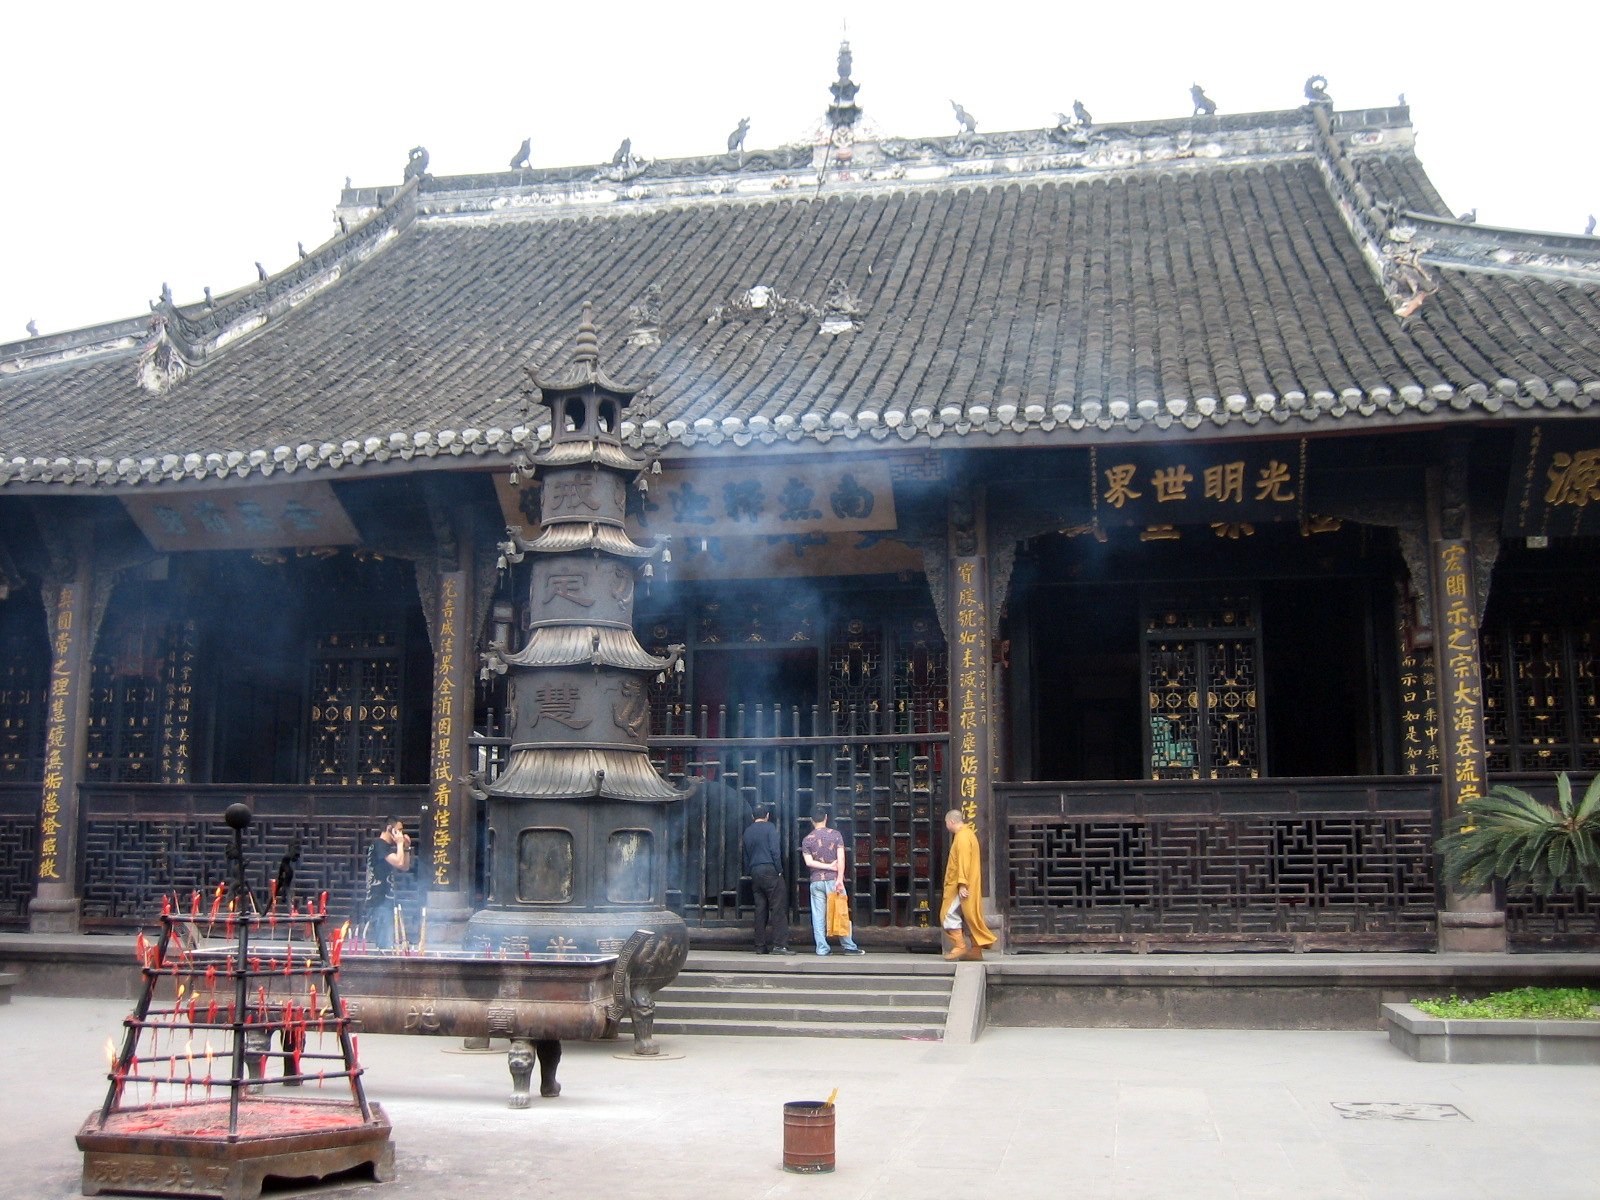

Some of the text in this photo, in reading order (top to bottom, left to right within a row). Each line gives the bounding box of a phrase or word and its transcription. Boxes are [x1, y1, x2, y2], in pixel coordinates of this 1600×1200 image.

[550, 473, 600, 511] 戒
[542, 567, 596, 607] 定
[530, 682, 593, 730] 慧
